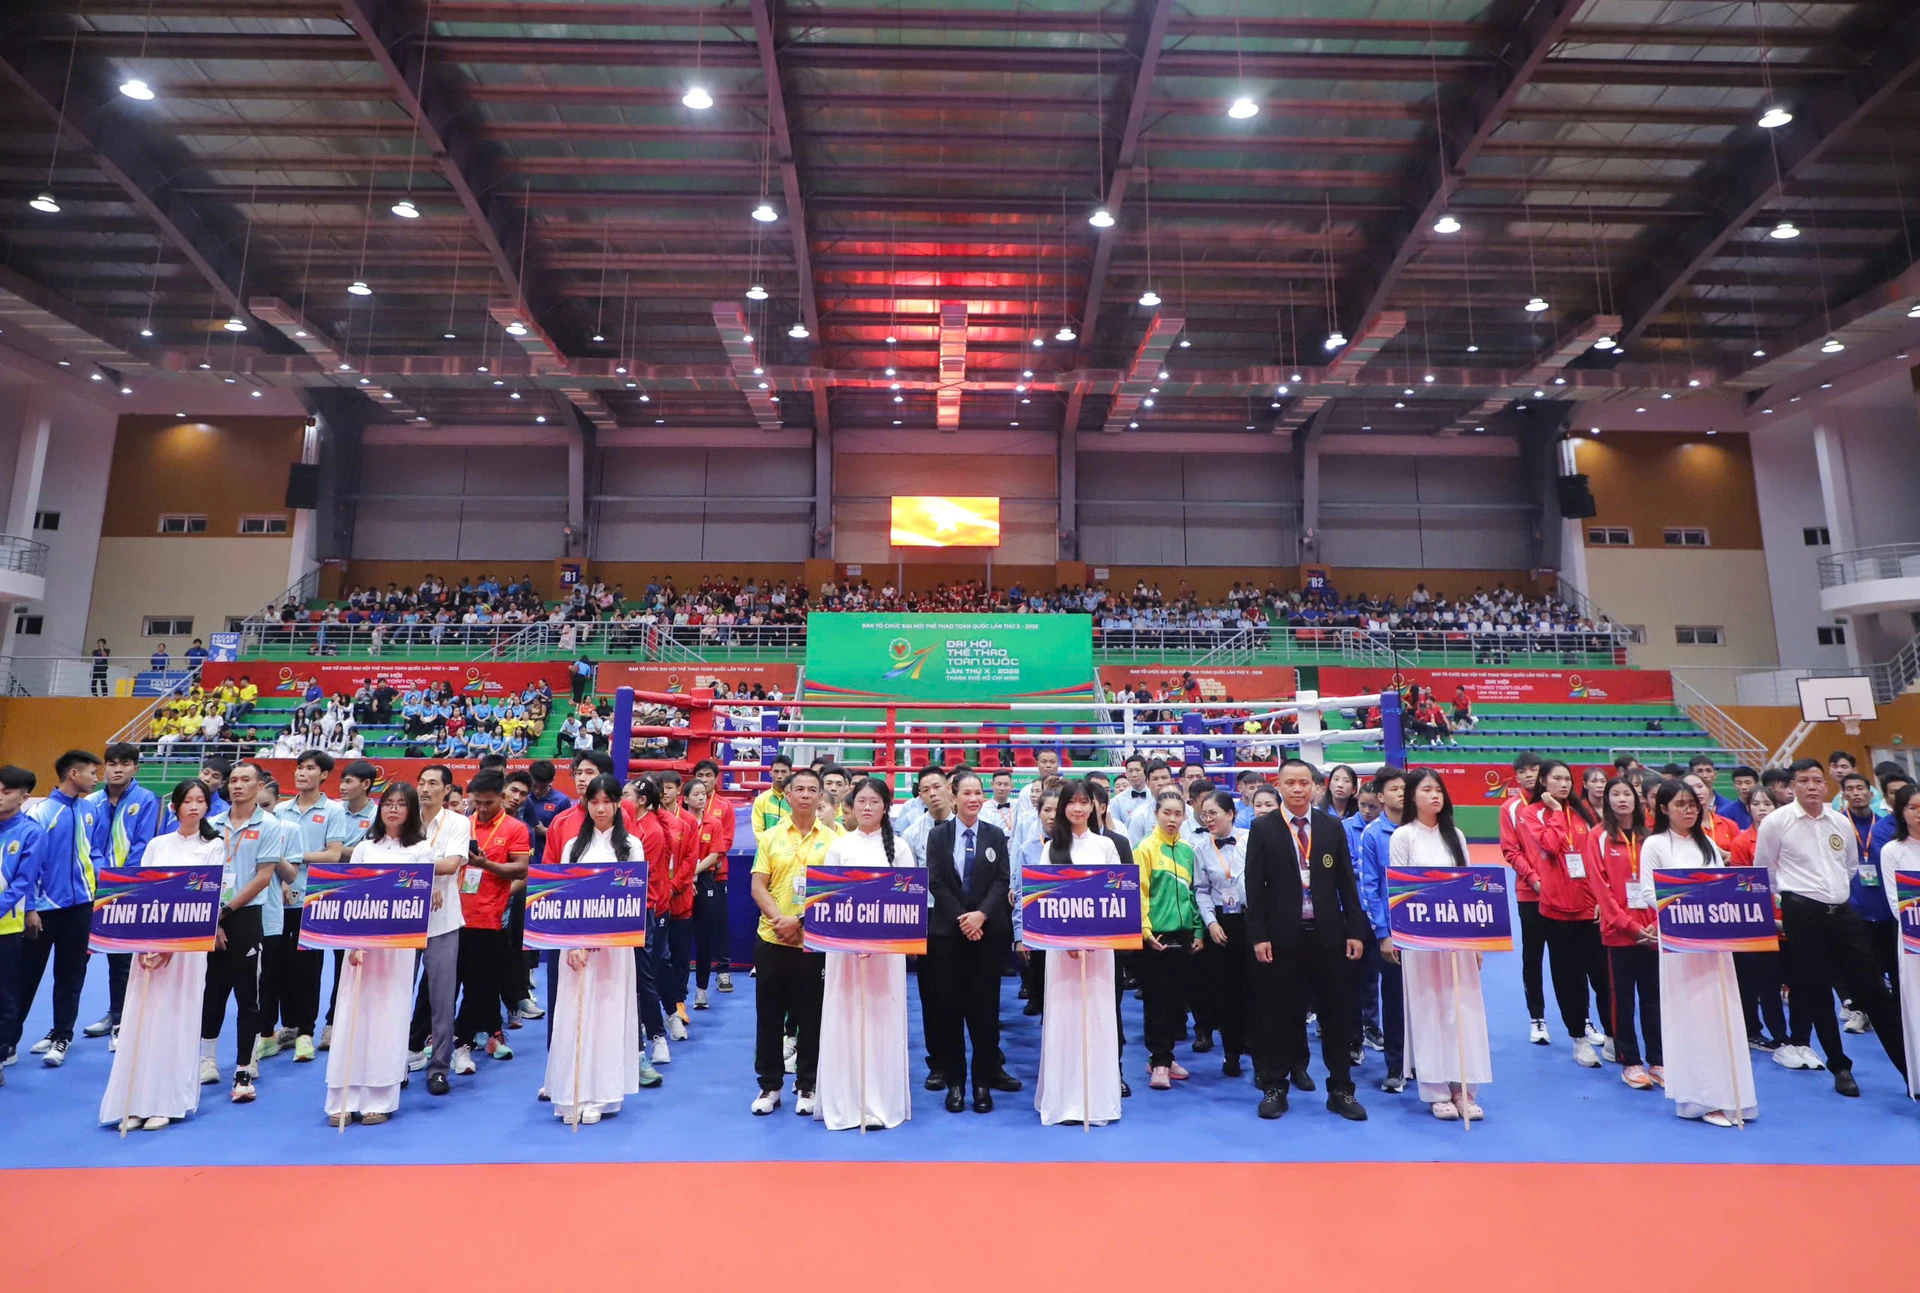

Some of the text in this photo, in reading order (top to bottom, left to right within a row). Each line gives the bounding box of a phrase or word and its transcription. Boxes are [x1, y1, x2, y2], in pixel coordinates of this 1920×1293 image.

[565, 571, 576, 582] B1
[1311, 577, 1323, 587] B2
[970, 639, 992, 649] HỘI
[946, 656, 1019, 666] TOÀN QUỐC
[102, 898, 212, 924] TỈNH TÂY NINH
[310, 893, 424, 921] TỈNH QUẢNG NGÃI
[531, 894, 640, 920] CÔNG AN NHÂN DÂN
[814, 896, 919, 924] TP. HỒ CHÍ MINH
[1038, 893, 1126, 923] TRỌNG TÀI
[1406, 899, 1493, 927] TP. HÀ NỘI
[1668, 898, 1764, 924] TỈNH SƠN LA
